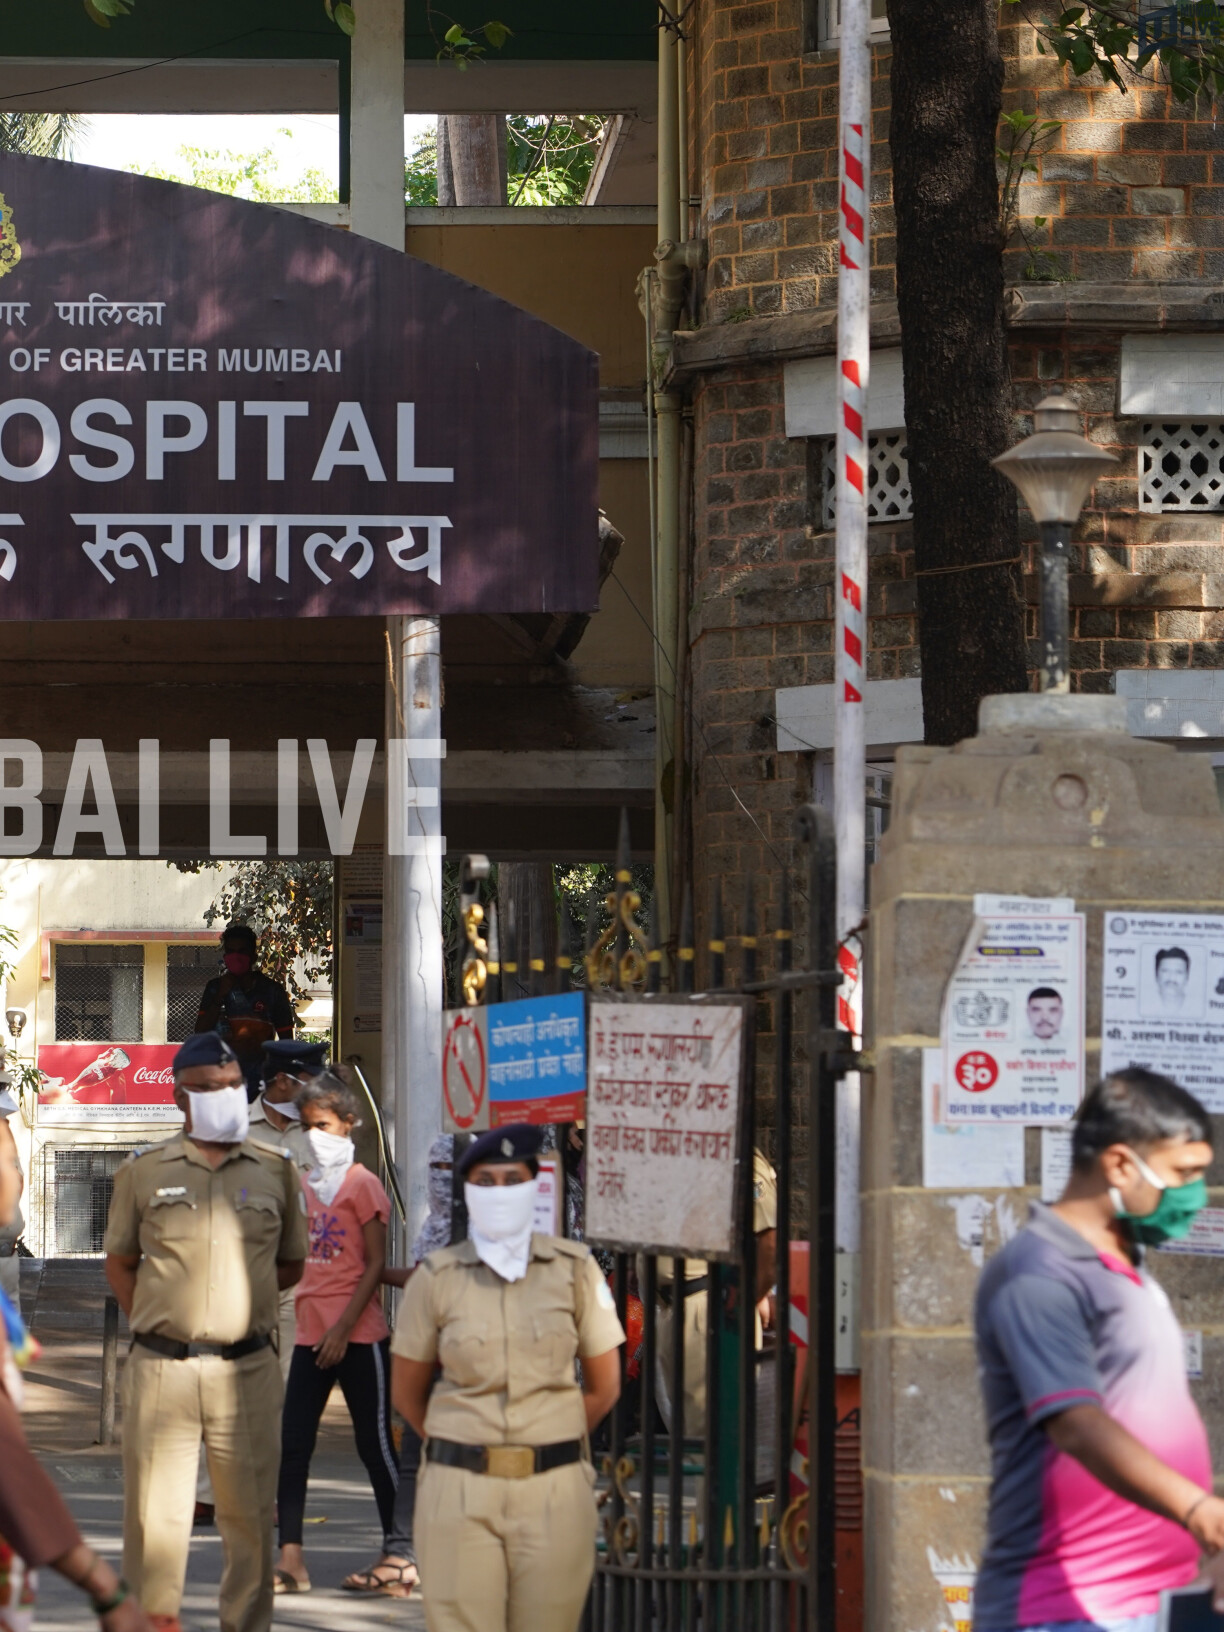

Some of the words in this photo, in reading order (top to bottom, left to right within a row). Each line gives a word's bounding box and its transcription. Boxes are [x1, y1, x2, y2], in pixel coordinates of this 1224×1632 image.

[54, 293, 166, 327] पालिका
[9, 348, 51, 372] OF
[59, 348, 208, 372] GREATER
[218, 349, 341, 372] MUMBAI
[491, 1015, 535, 1048] कोणत्याही
[537, 1048, 561, 1078] प्रवेश
[561, 1045, 584, 1077] नाही
